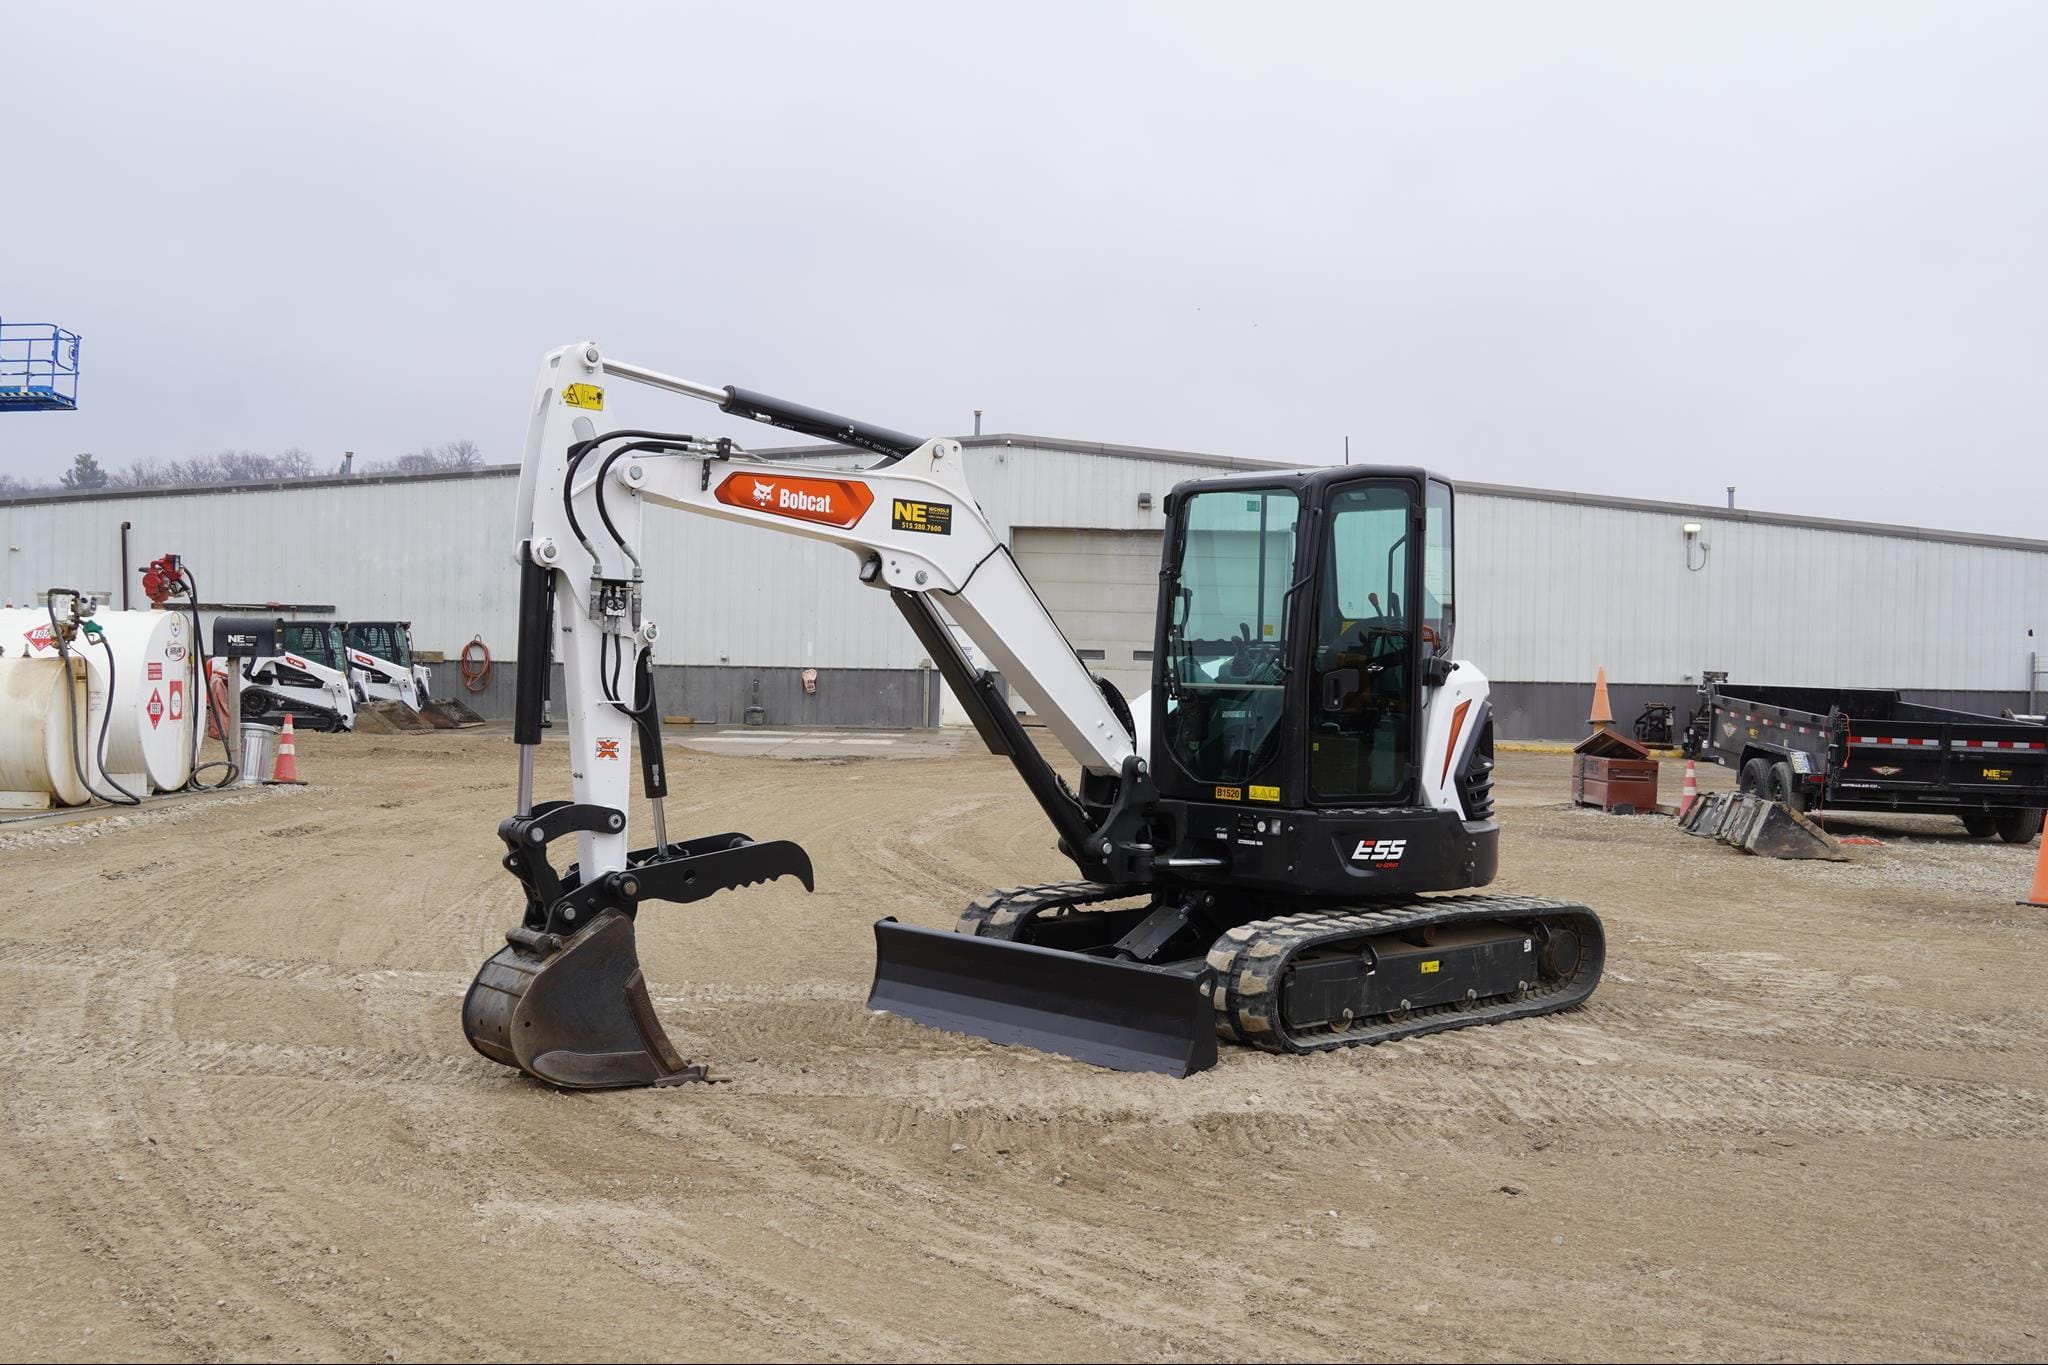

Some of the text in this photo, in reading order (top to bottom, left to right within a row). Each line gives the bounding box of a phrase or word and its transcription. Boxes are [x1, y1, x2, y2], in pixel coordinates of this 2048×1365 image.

[779, 488, 832, 513] Bobcat
[894, 501, 928, 523] NE
[227, 634, 246, 643] NE
[1982, 769, 2001, 778] NE
[1217, 788, 1240, 799] B1520
